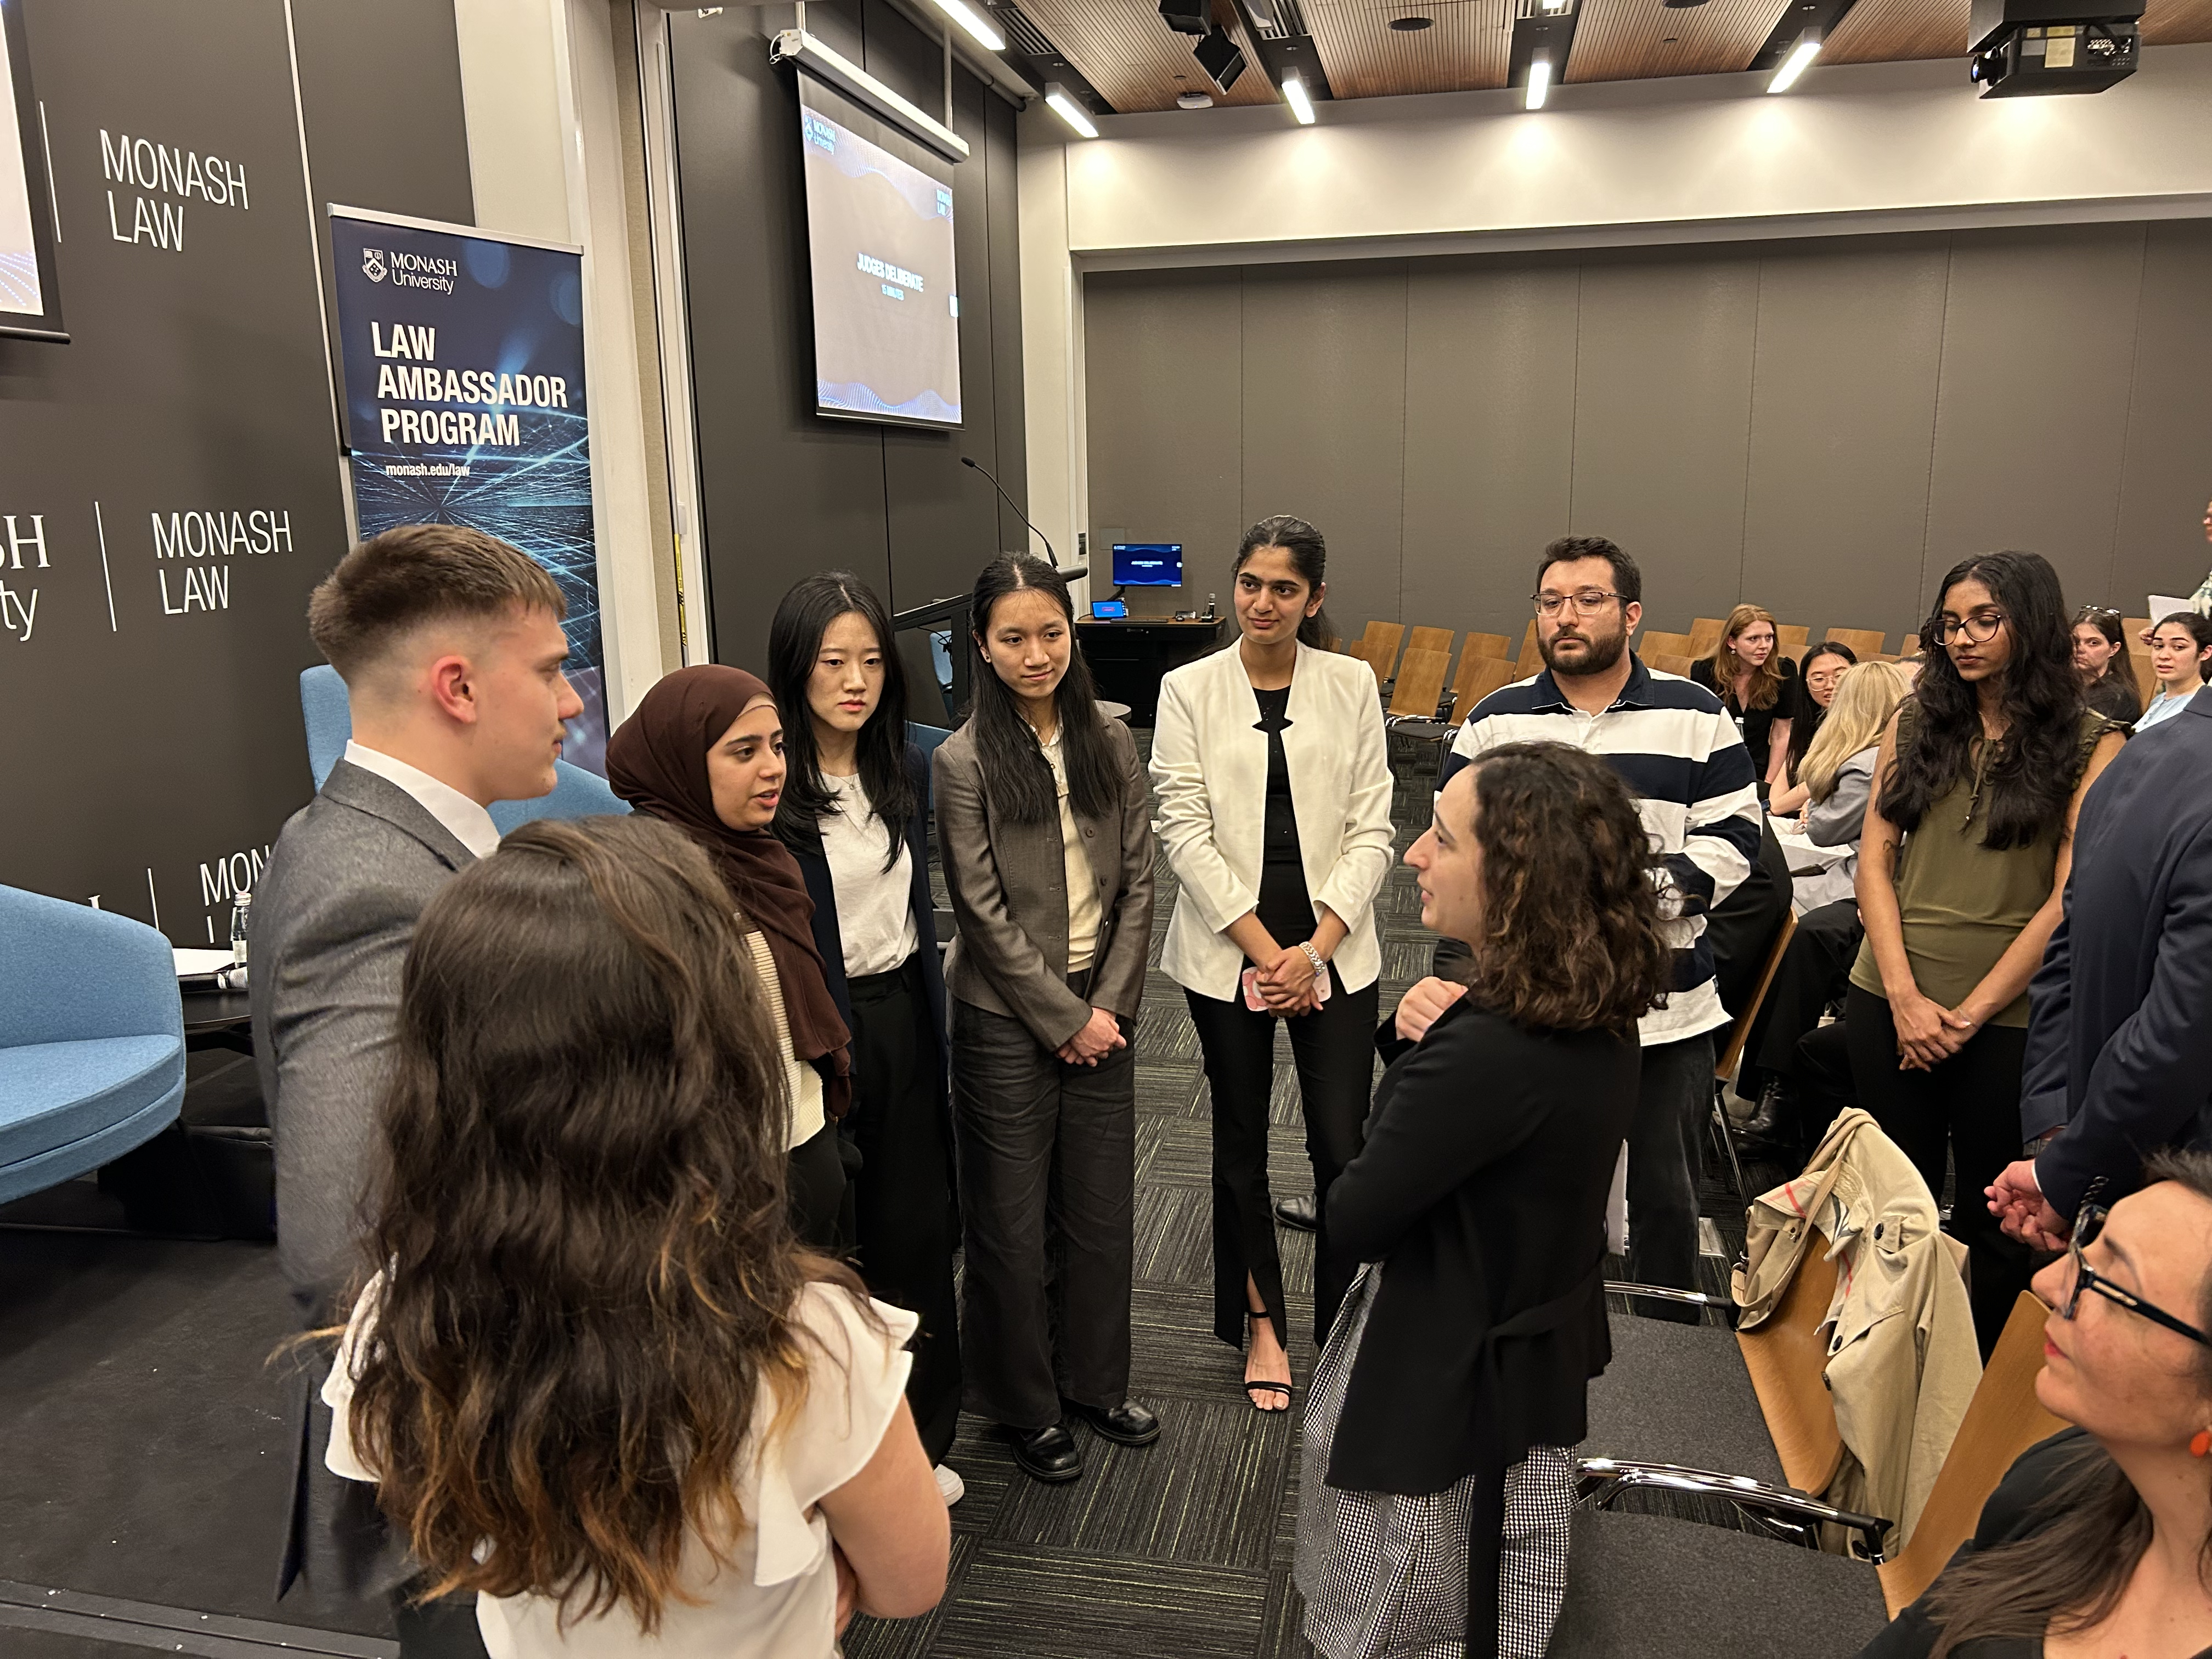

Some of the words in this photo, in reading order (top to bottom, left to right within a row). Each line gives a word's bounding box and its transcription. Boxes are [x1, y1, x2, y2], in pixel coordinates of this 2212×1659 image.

[100, 129, 249, 210] MONASH
[108, 190, 184, 252] LAW
[390, 251, 458, 277] MONASH
[392, 269, 454, 295] University
[857, 252, 884, 279] JUDGES
[371, 321, 436, 361] LAW
[377, 364, 568, 408] AMBASSADOR
[381, 408, 520, 447] PROGRAM
[385, 463, 471, 477] monash.edu/law
[0, 514, 51, 569] H
[151, 510, 293, 559] MONASH
[159, 565, 229, 614] LAW
